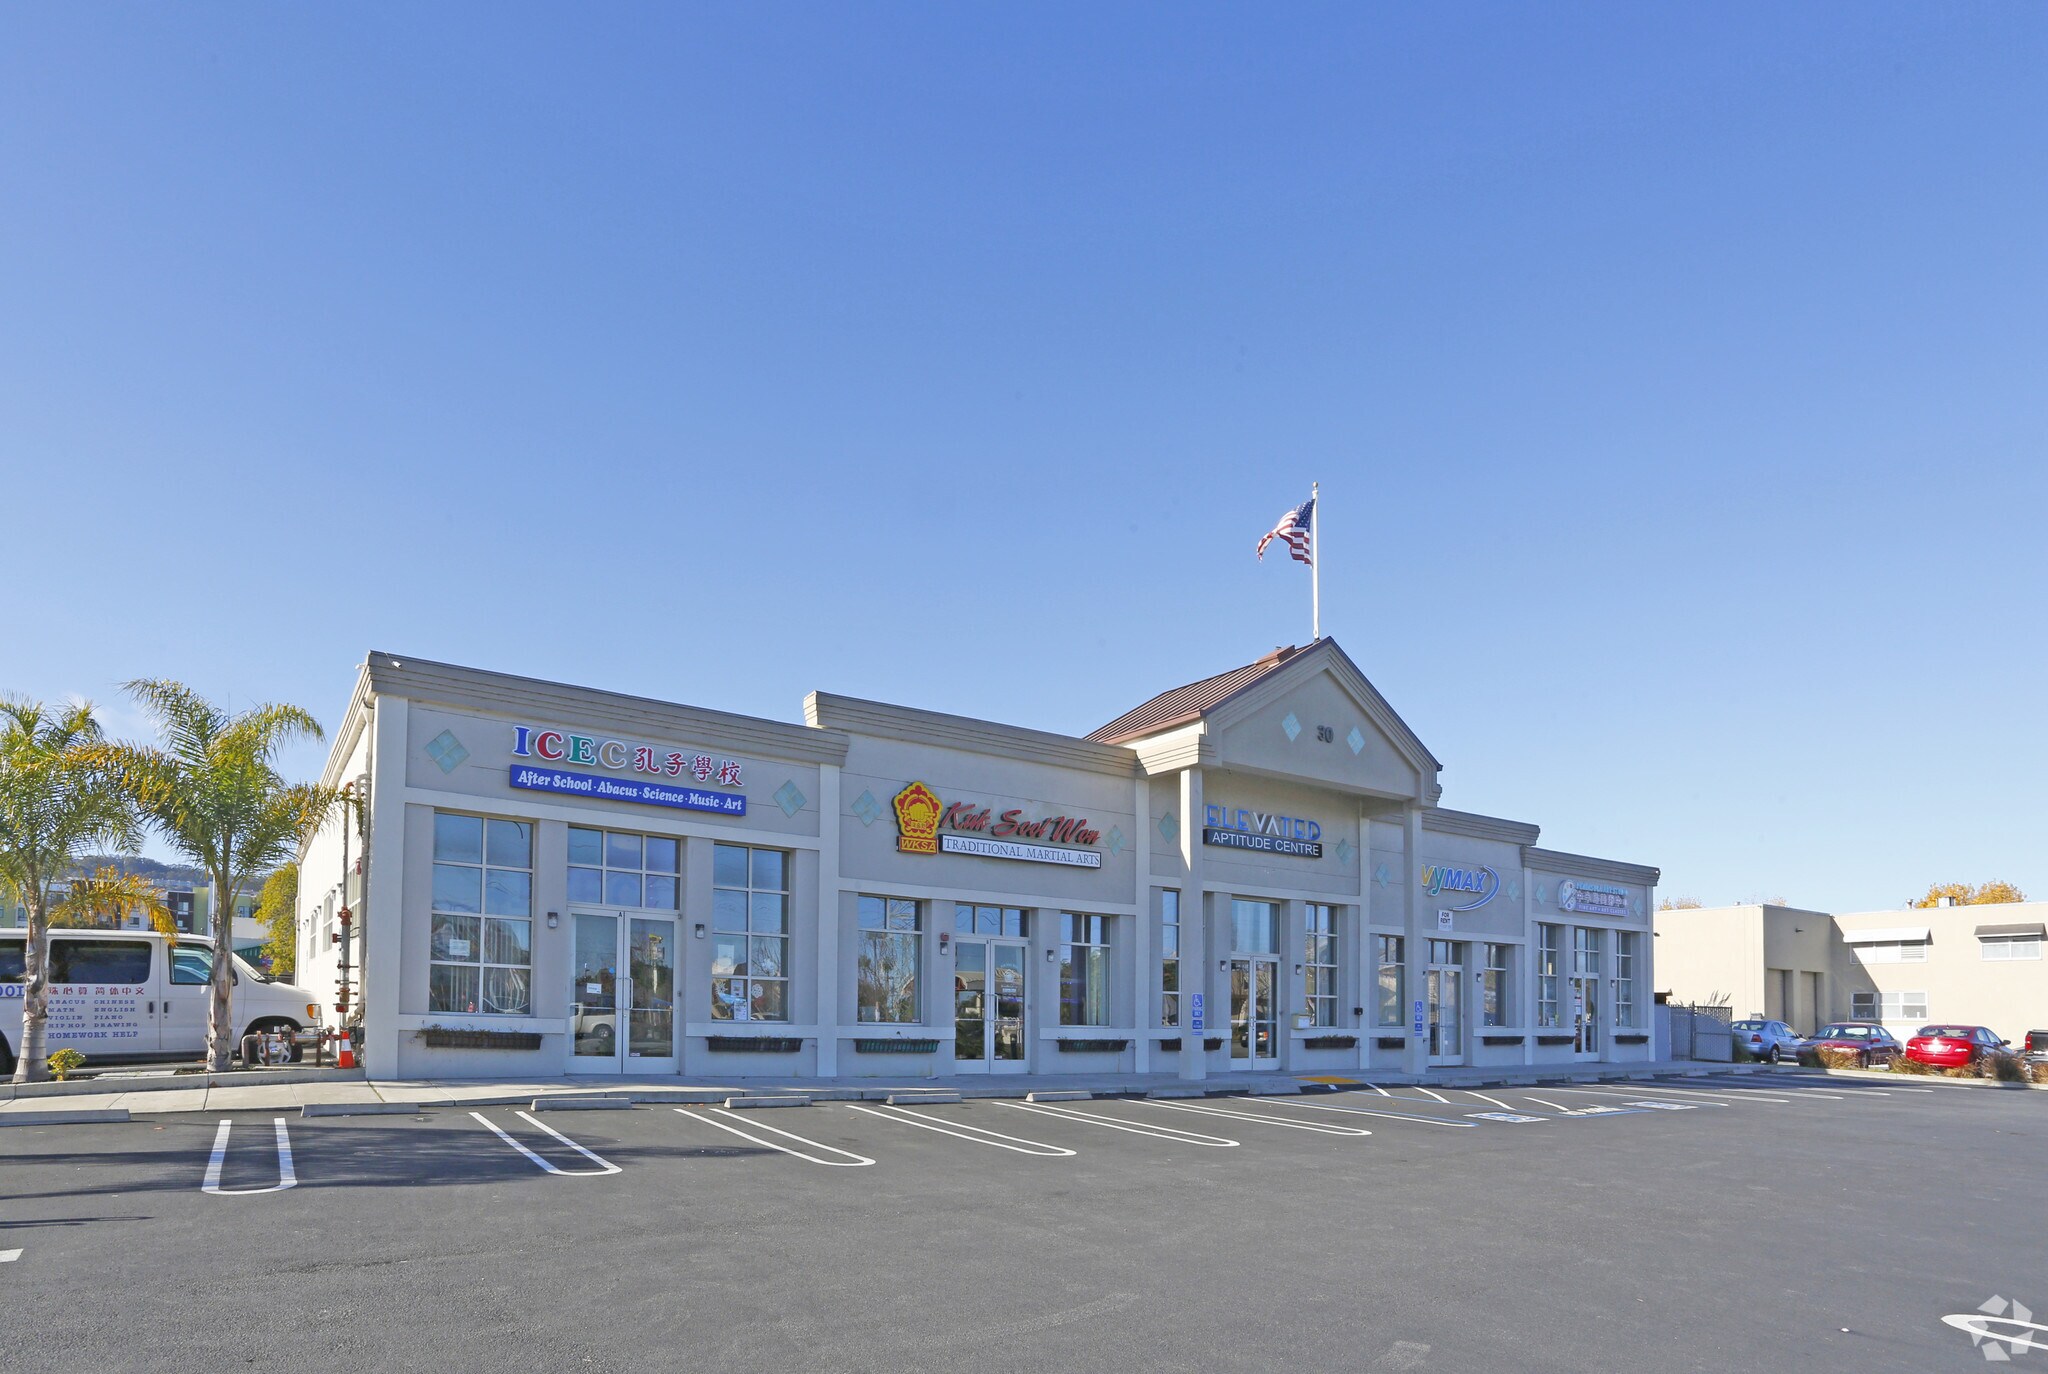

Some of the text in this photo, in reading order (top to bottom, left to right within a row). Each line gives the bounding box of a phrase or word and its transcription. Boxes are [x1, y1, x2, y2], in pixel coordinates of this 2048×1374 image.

[513, 726, 627, 769] ICEC
[1317, 725, 1334, 743] 30
[633, 746, 744, 787] 孔子學校
[518, 771, 742, 811] After School Abacus Science Music Art
[1049, 815, 1101, 845] Won
[1206, 805, 1321, 841] ELEVATED
[902, 839, 936, 850] WKSA
[944, 838, 1100, 866] TRADITIONAL MARTIAL ARTS
[1212, 832, 1319, 856] APTITUDE CENTRE
[48, 1031, 108, 1039] HOMEWORK
